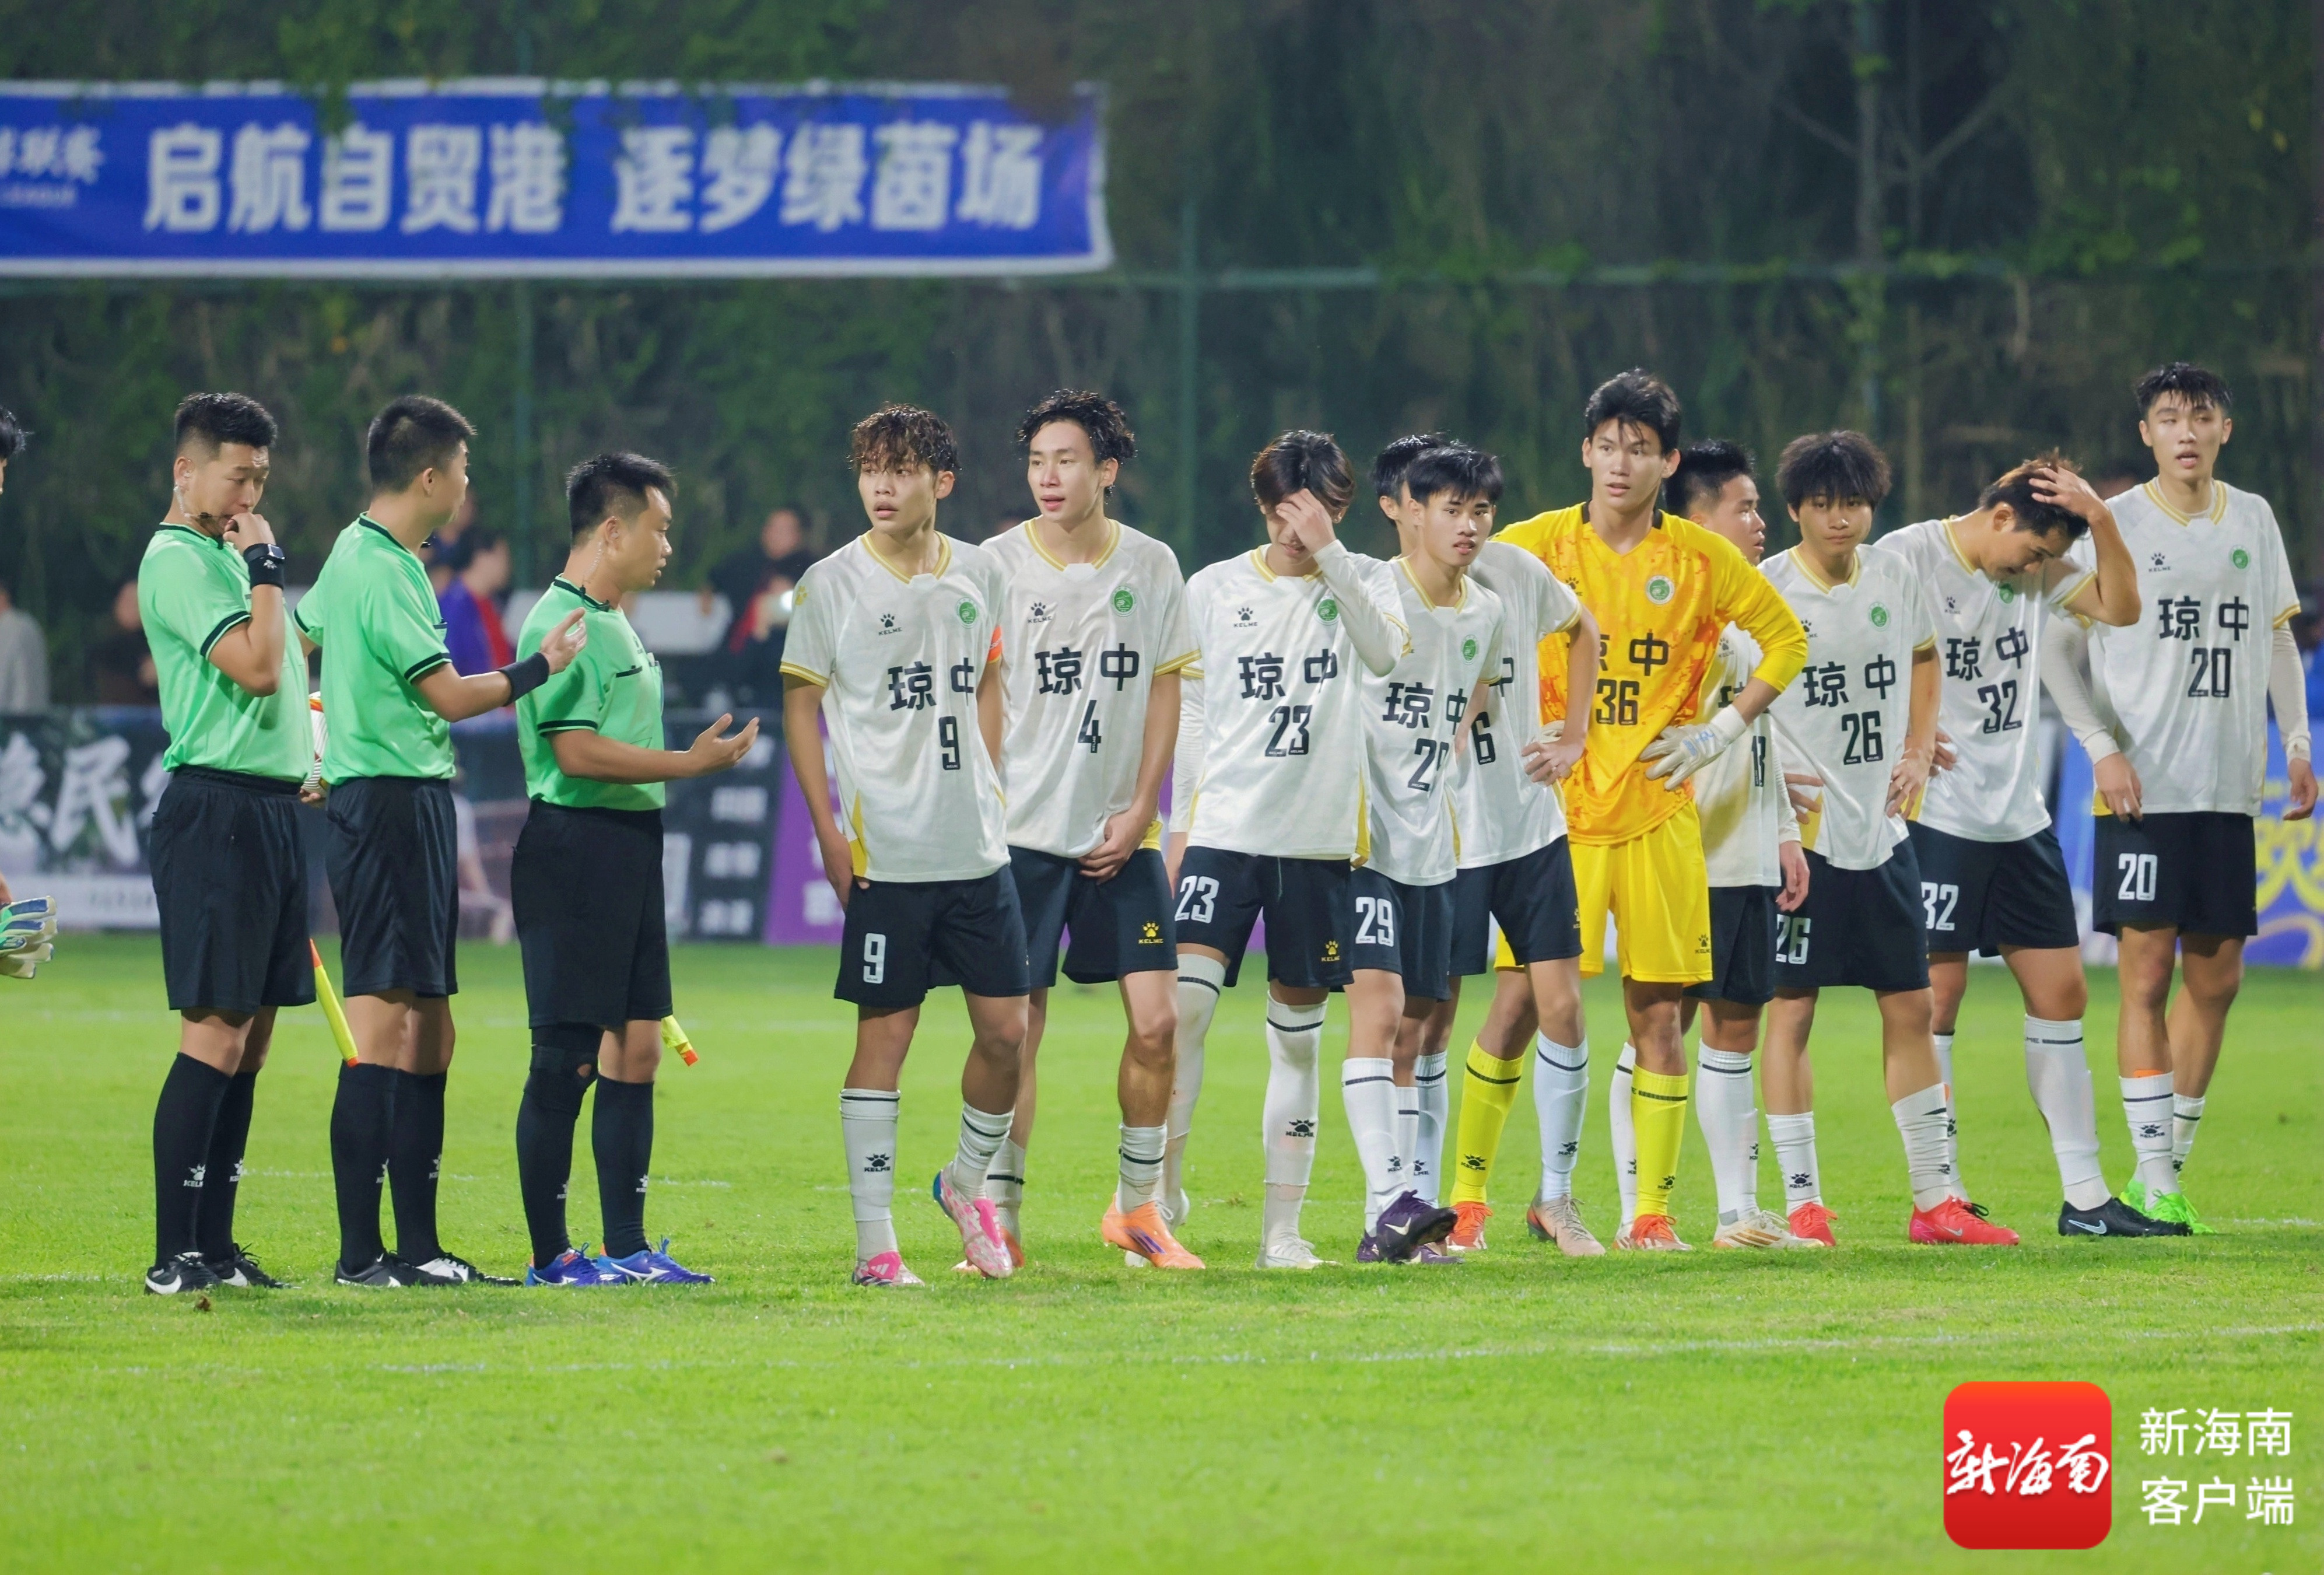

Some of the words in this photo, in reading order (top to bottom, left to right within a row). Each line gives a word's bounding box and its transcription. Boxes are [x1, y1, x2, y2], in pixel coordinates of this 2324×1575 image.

[143, 121, 567, 233] 启航自贸港
[611, 120, 1044, 233] 逐梦绿茵场
[878, 626, 903, 636] KELME
[1028, 615, 1052, 624] KELME
[2158, 596, 2249, 641] 琼中
[1035, 642, 1140, 695] 琼中
[1238, 648, 1337, 701] 琼中
[1946, 626, 2029, 681] 琼中
[2188, 648, 2231, 698] 20
[1596, 678, 1640, 726] 36
[1801, 653, 1895, 708] 琼中
[1078, 699, 1102, 754] 4
[1264, 704, 1313, 757] 23
[1382, 681, 1468, 735] 琼中
[1977, 679, 2022, 734] 32
[938, 715, 961, 771] 9
[1841, 710, 1884, 765] 26
[1174, 875, 1220, 924] 23
[2118, 853, 2158, 901] 20
[1355, 897, 1394, 947] 29
[1920, 881, 1960, 932] 32
[863, 933, 886, 984] 9
[1776, 914, 1811, 965] 26
[1460, 1162, 1485, 1171] KELME
